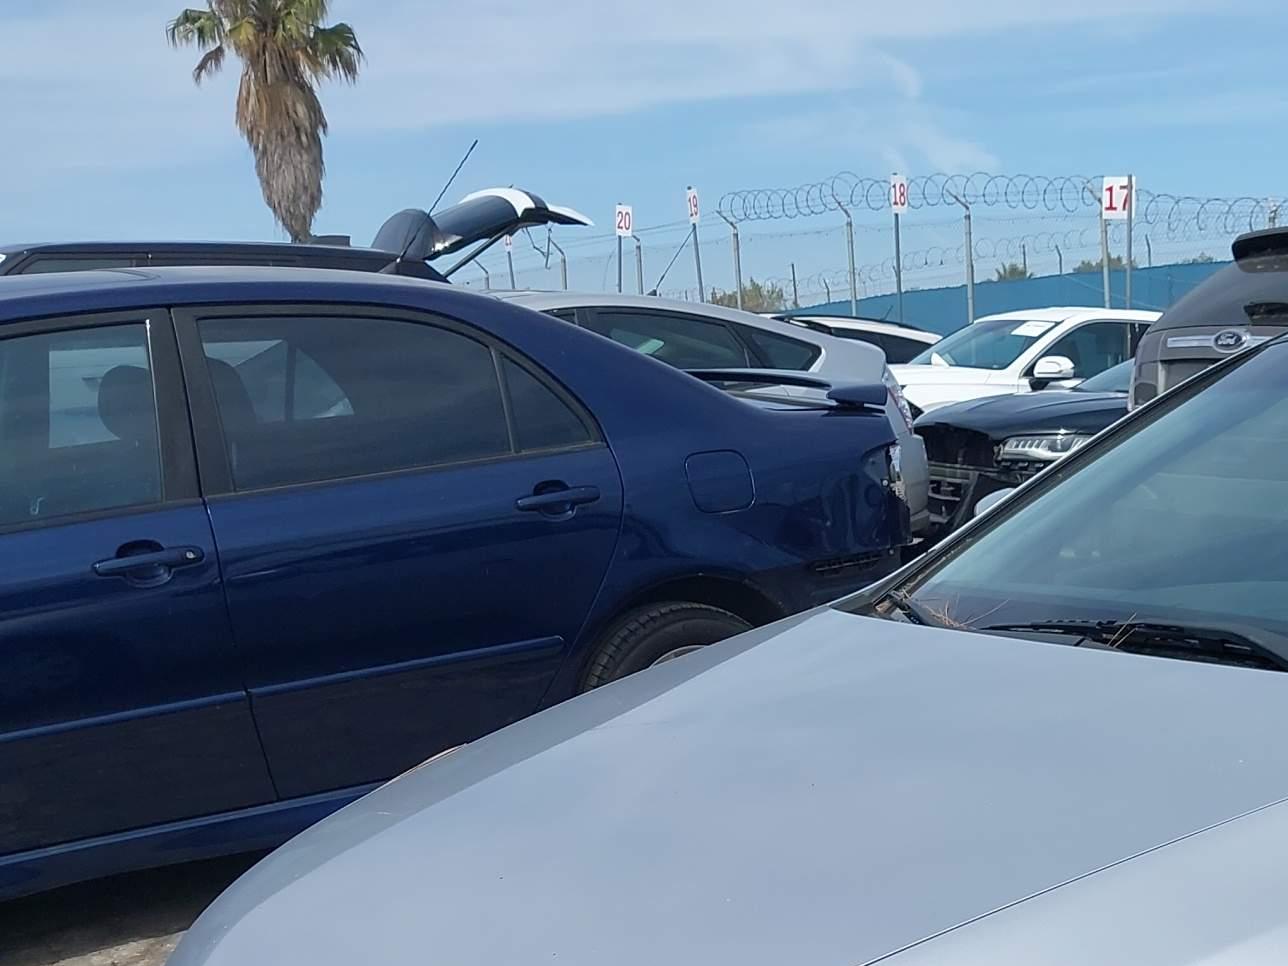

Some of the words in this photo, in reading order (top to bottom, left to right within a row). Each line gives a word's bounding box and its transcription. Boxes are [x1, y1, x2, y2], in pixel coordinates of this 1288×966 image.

[688, 194, 699, 217] 19
[891, 183, 906, 206] 18
[1104, 184, 1132, 211] 17
[616, 210, 631, 231] 20
